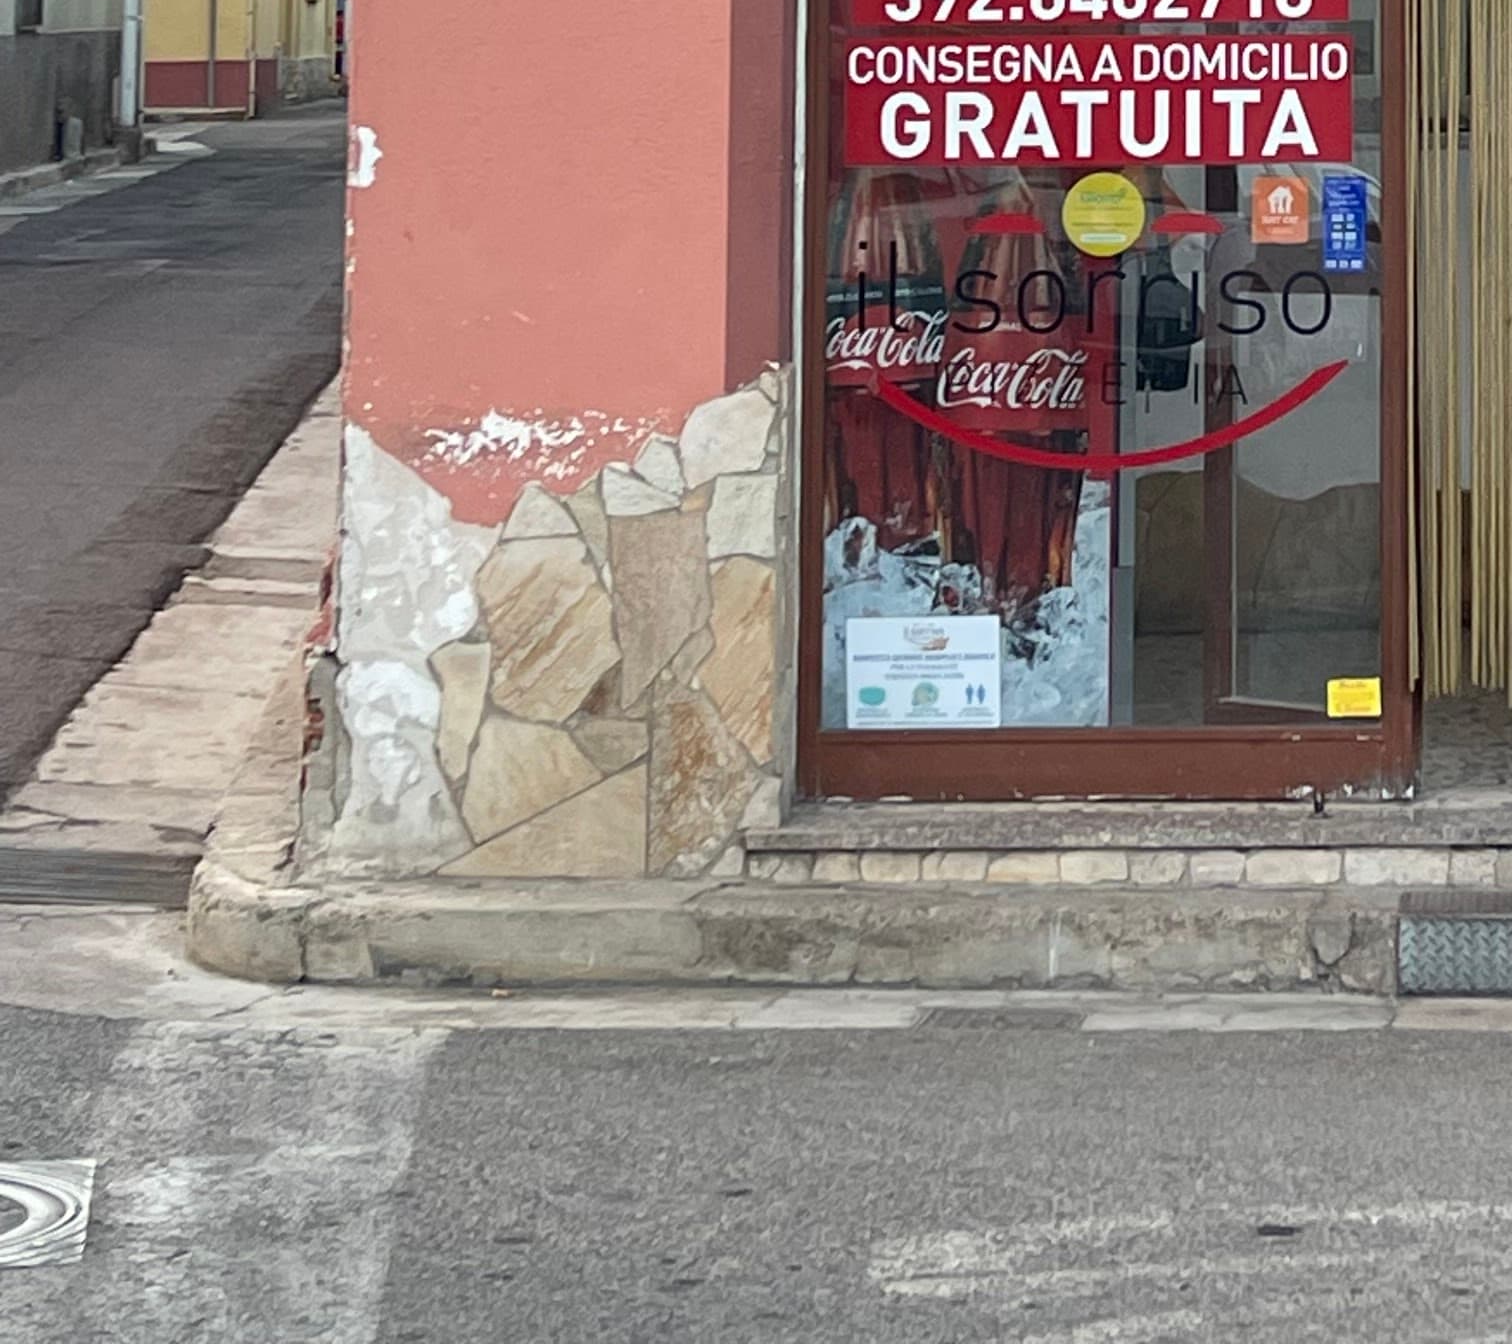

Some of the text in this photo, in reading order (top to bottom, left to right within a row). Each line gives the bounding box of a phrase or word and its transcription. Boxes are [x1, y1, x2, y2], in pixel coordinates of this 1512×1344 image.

[848, 42, 1349, 84] CONSEGNA A DOMICILIO
[880, 88, 1319, 159] GRATUITA
[858, 241, 1332, 335] il sorriso
